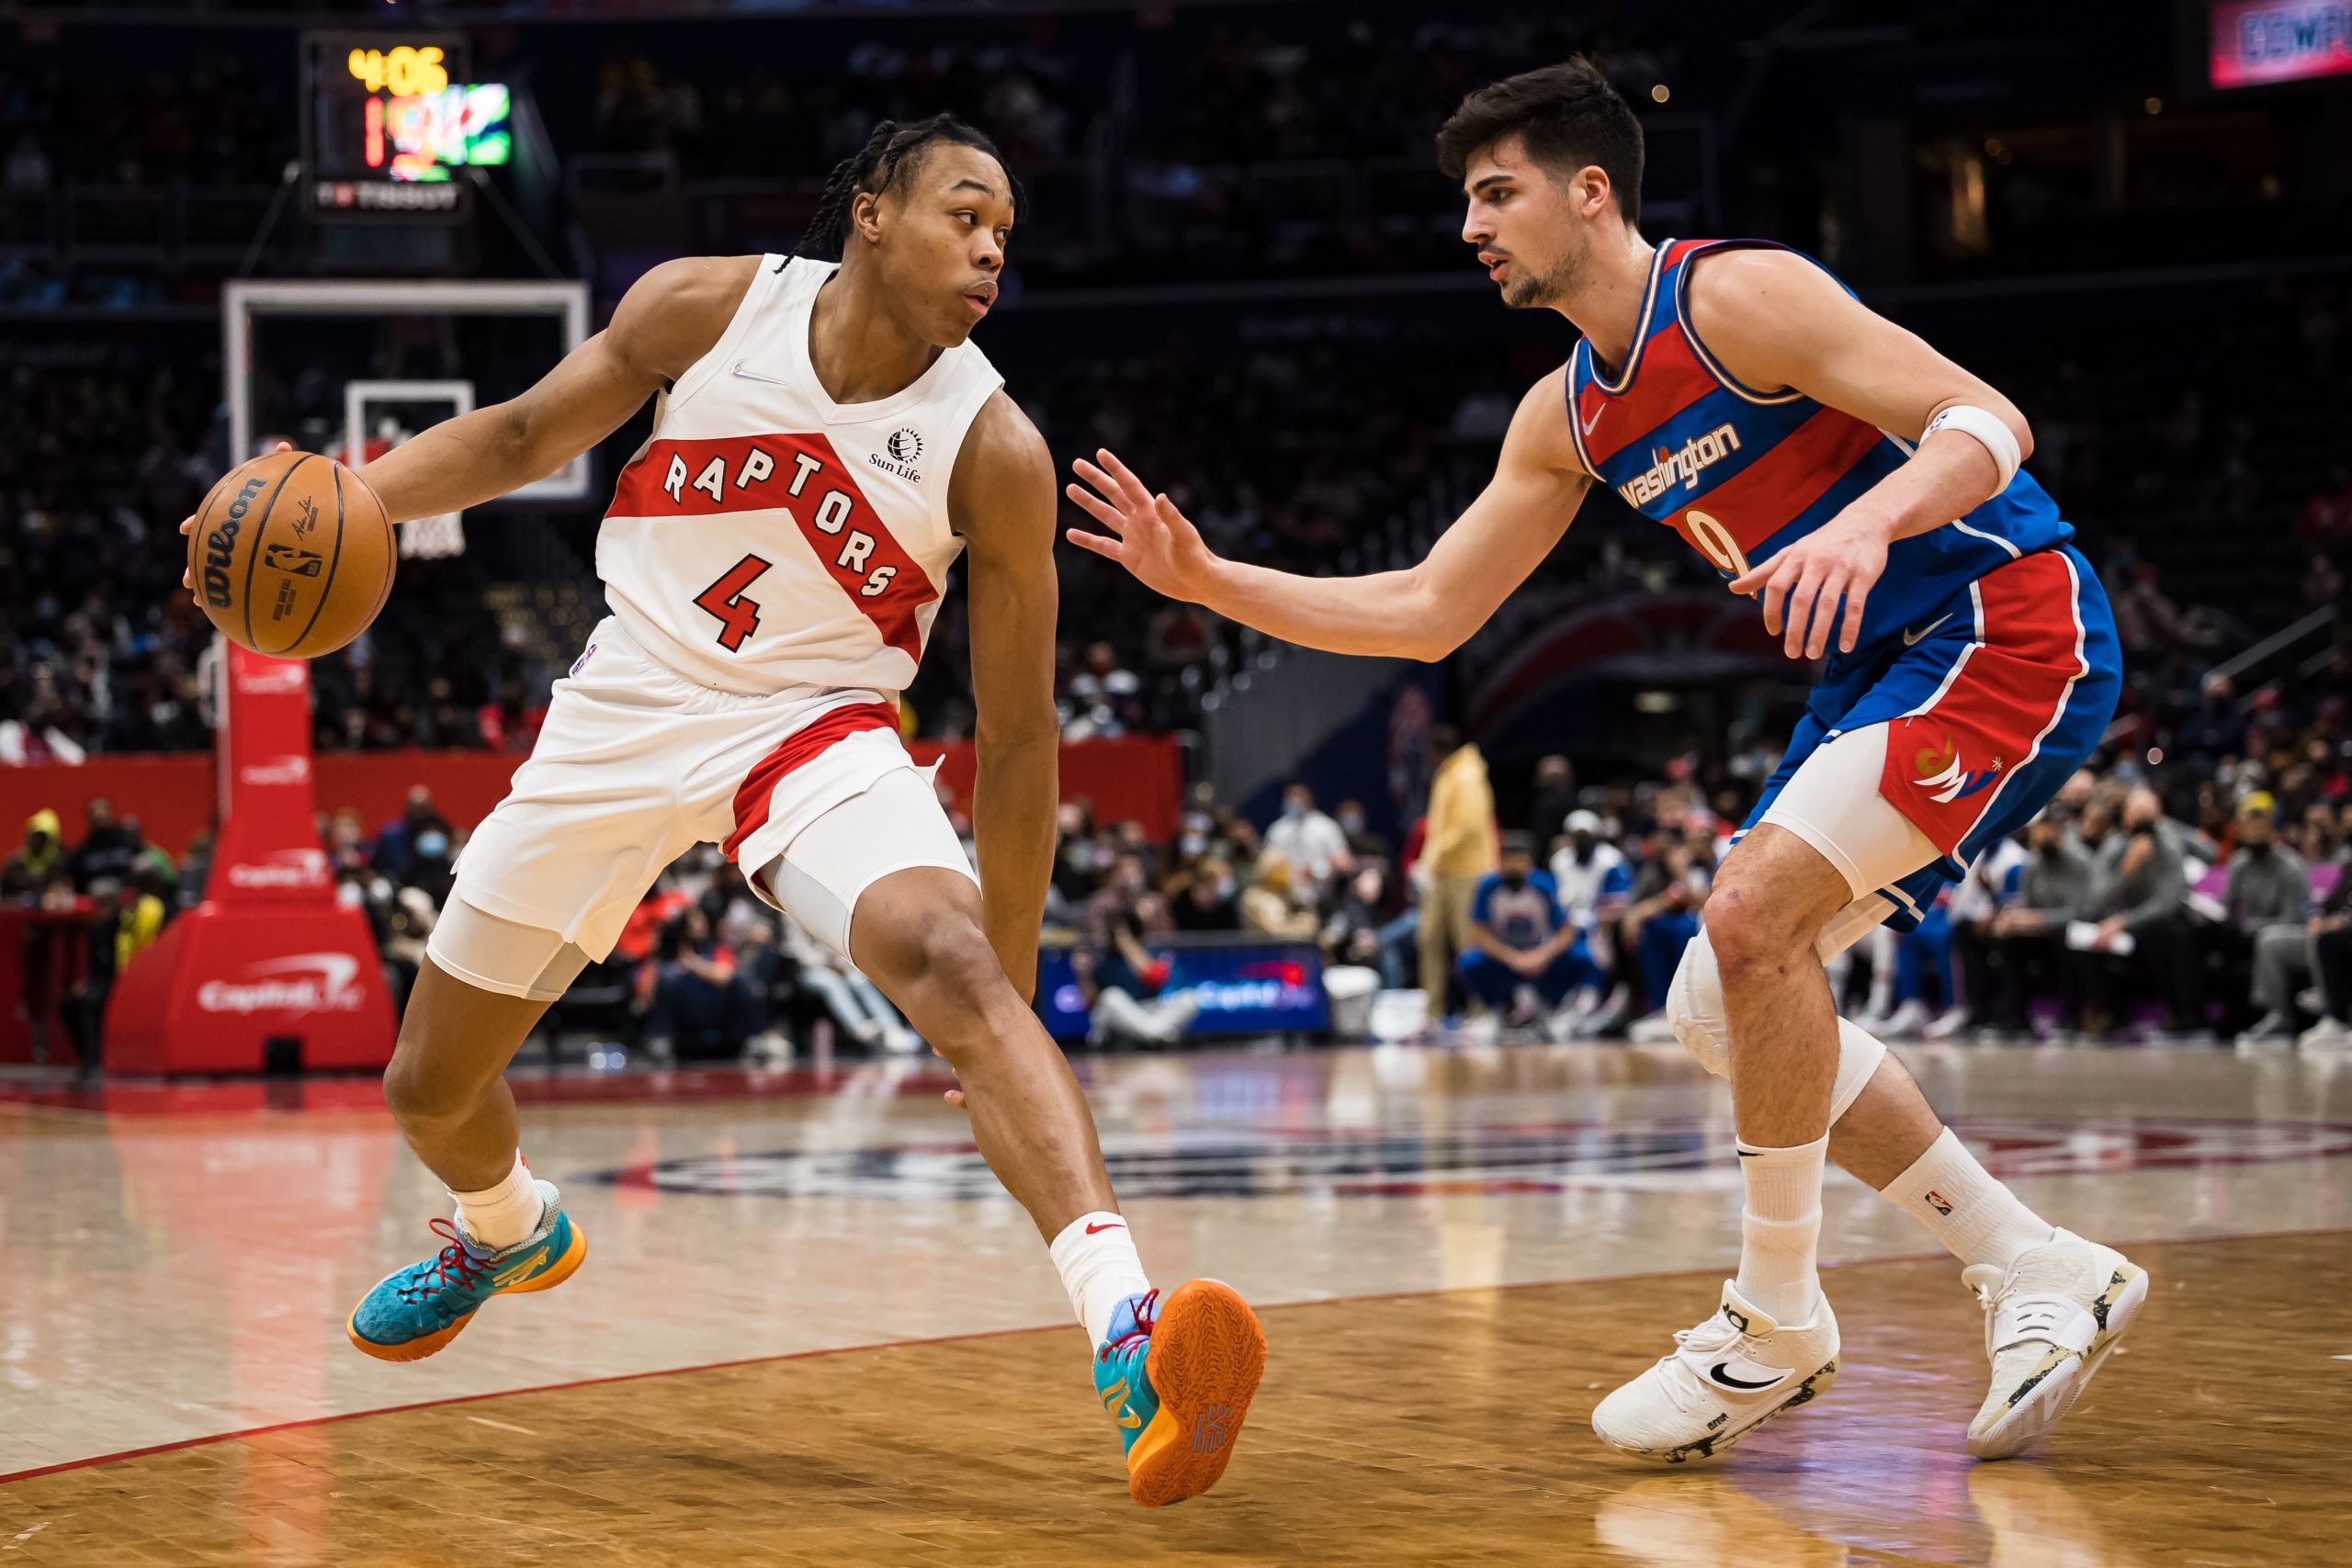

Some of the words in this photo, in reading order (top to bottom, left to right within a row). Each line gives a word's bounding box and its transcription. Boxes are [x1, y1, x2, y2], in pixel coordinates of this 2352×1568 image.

[868, 453, 895, 473] Sun
[896, 464, 922, 483] Life
[662, 446, 899, 597] RAPTORS
[1684, 508, 1758, 600] 9
[692, 552, 774, 653] 4
